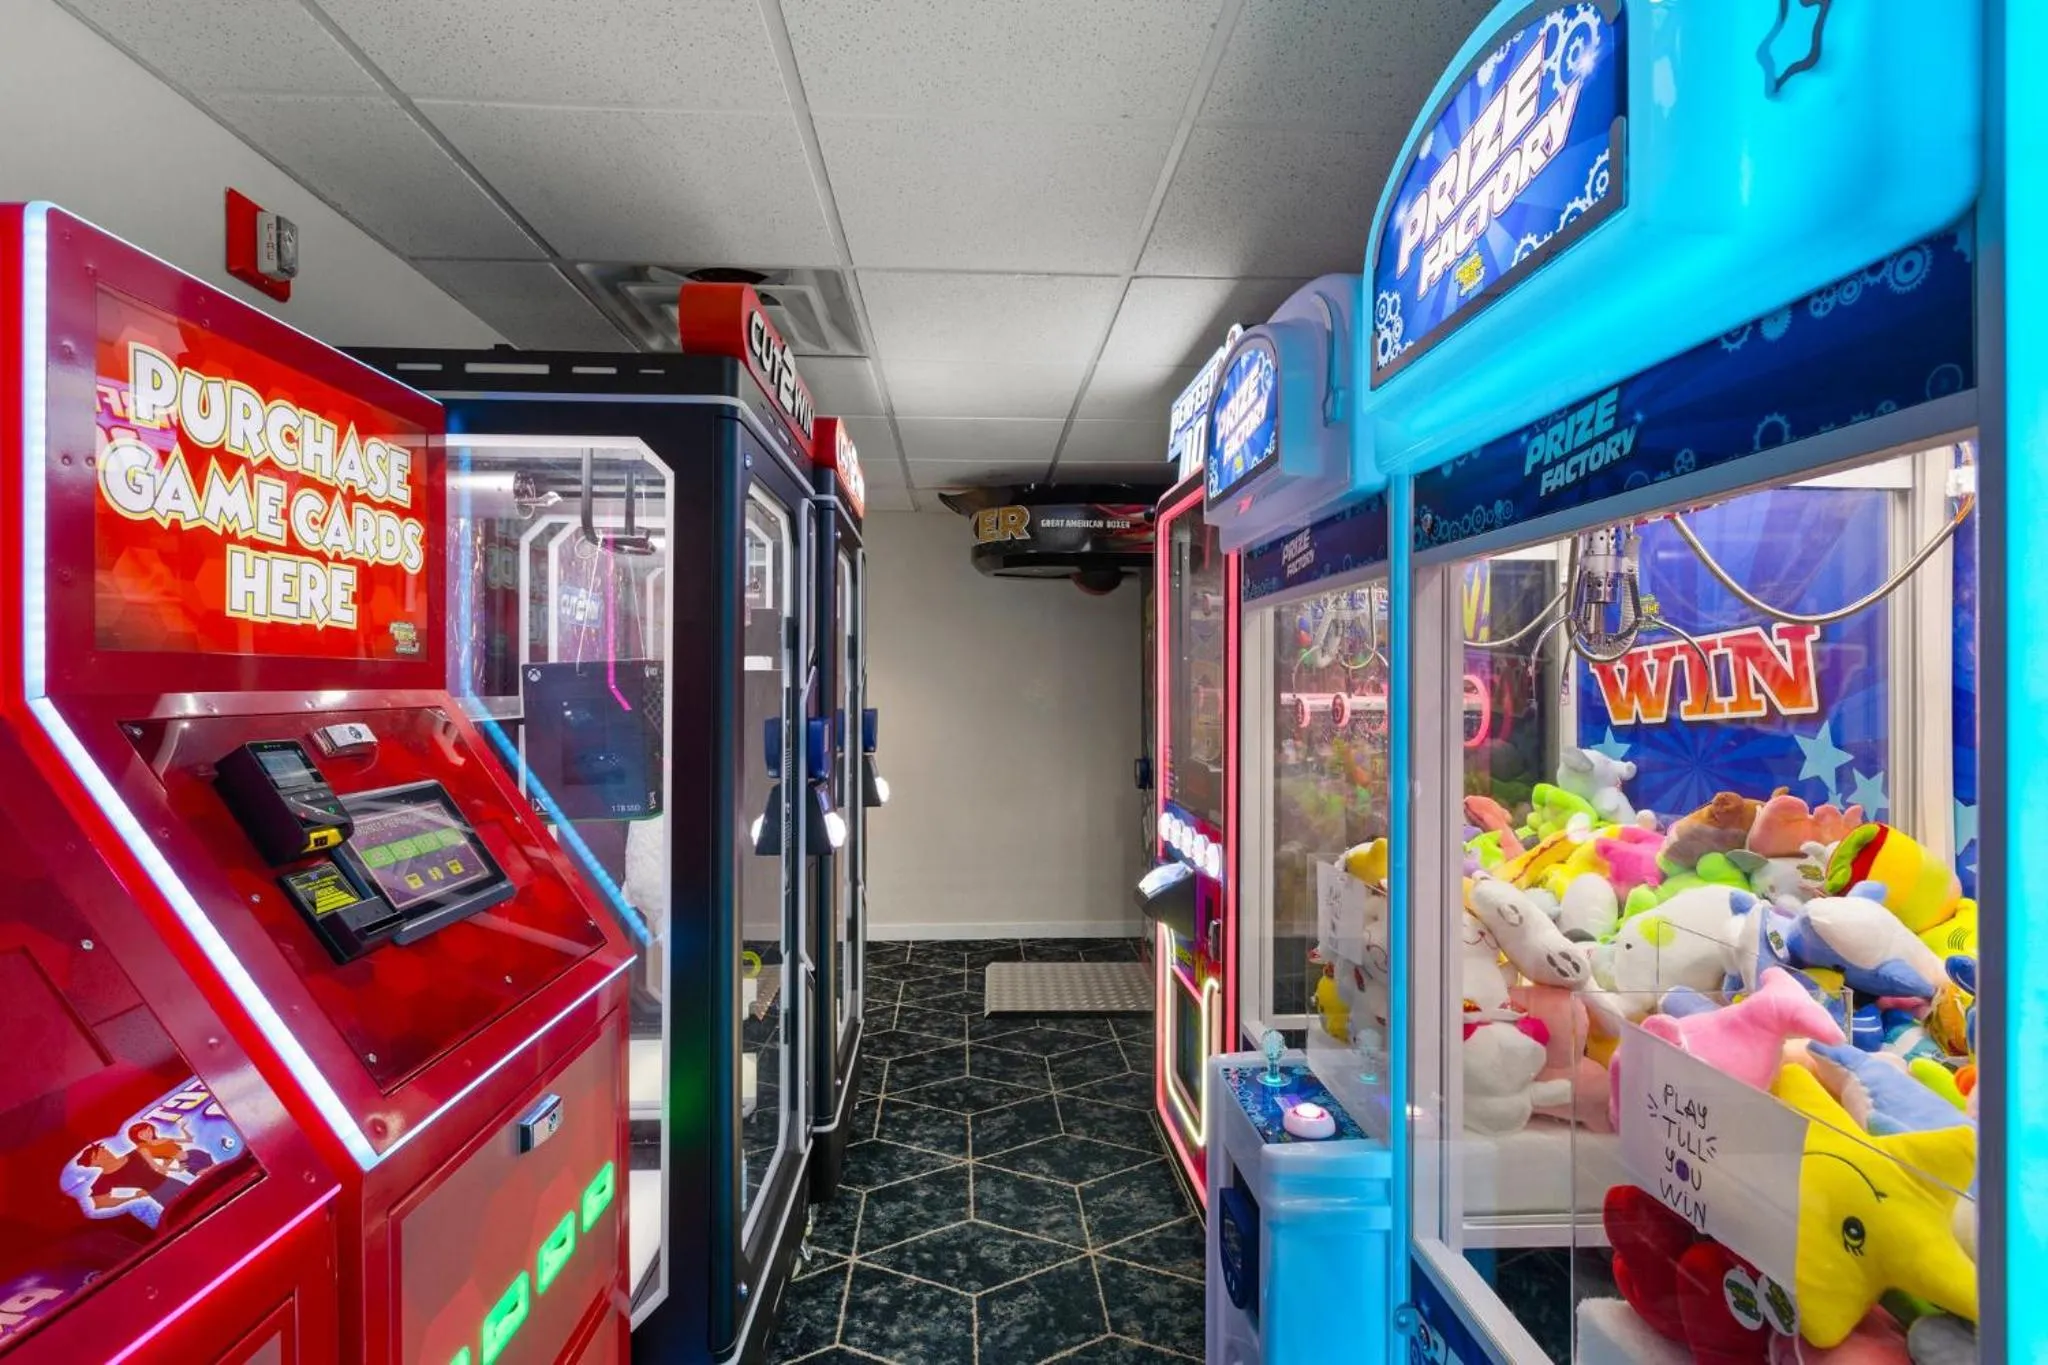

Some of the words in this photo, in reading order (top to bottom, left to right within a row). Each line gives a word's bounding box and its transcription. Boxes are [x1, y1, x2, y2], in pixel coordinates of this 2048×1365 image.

[1396, 34, 1548, 280] PRIZE
[1417, 75, 1583, 301] FACTORY
[266, 222, 275, 261] FIRE
[128, 341, 411, 508] PURCHASE
[1215, 362, 1262, 451] PRIZE
[1523, 387, 1619, 477] PRIZE
[1539, 424, 1638, 497] FACTORY
[98, 442, 288, 546] GAME
[290, 489, 425, 575] CARDS
[1041, 519, 1065, 529] GREAT
[1065, 519, 1104, 529] AMERICAN
[1105, 519, 1131, 529] BOXER
[1281, 527, 1311, 567] PRIZE
[225, 544, 358, 630] HERE
[1589, 621, 1821, 726] WIN
[1663, 1083, 1708, 1130] PLAY
